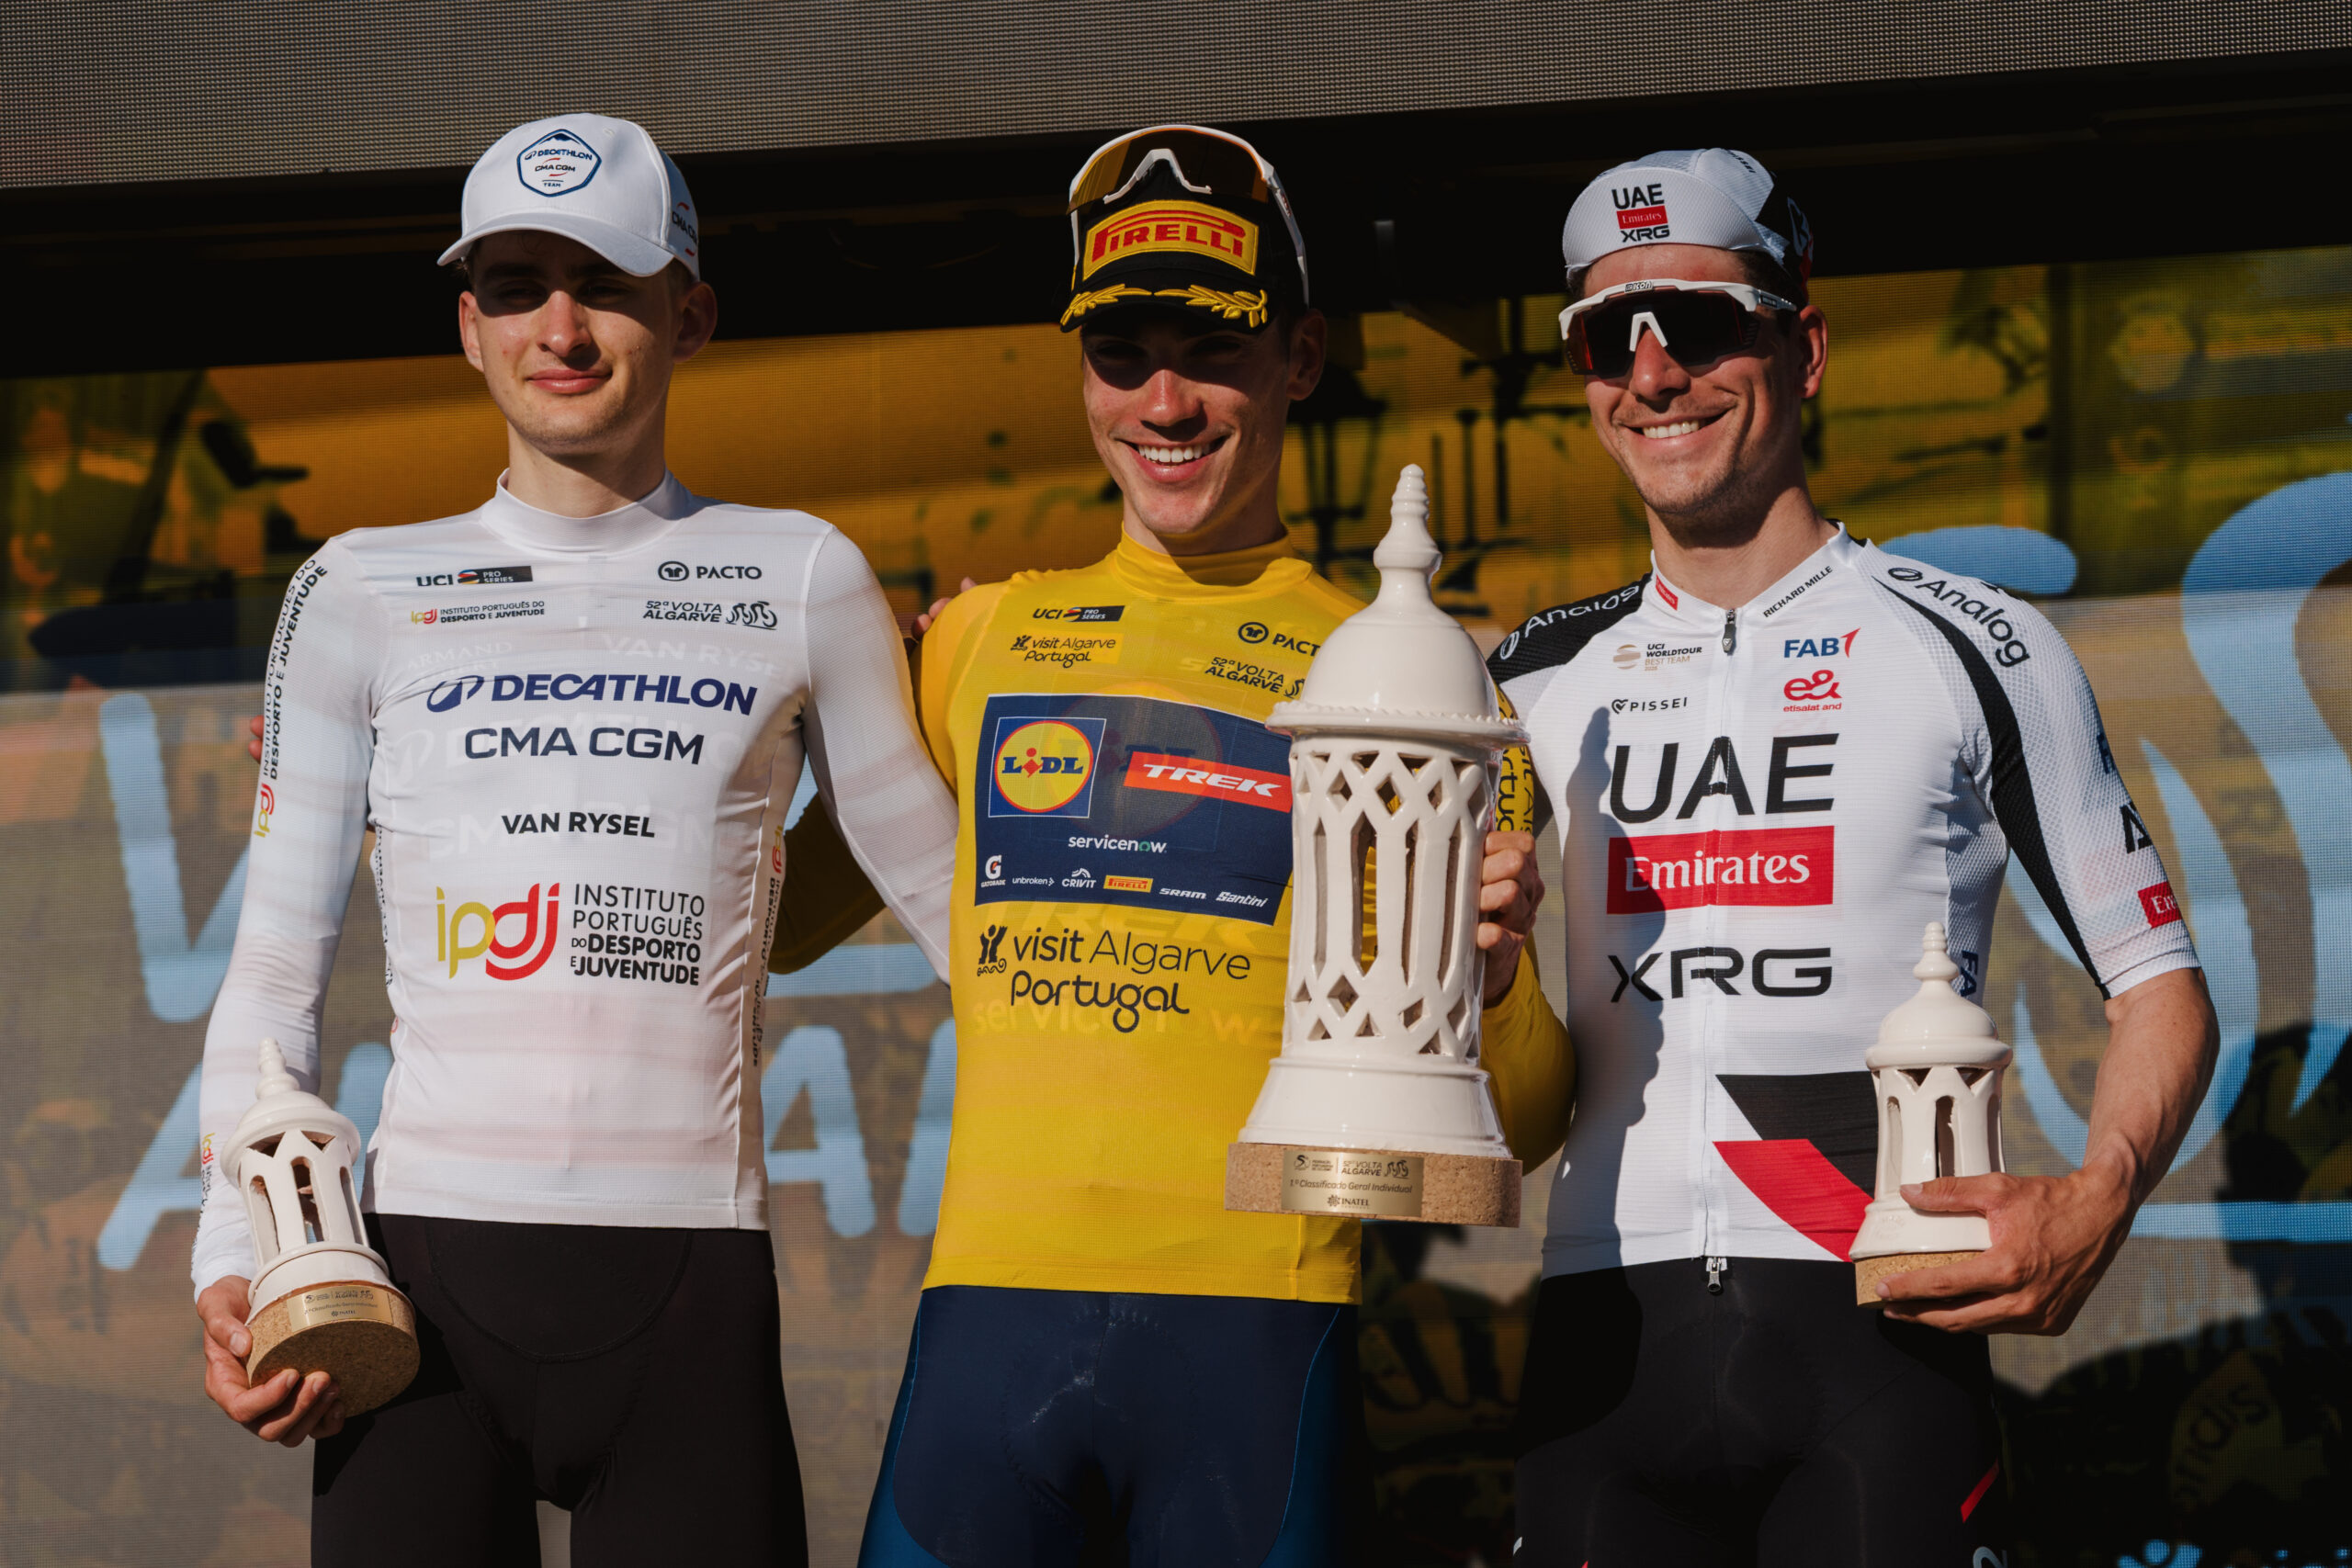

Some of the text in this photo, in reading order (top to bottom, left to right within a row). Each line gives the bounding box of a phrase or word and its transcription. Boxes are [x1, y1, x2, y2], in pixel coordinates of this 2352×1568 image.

[537, 149, 593, 161] DECATHLON
[1611, 183, 1665, 209] UAE
[672, 210, 688, 235] CMA
[1622, 211, 1662, 224] Emirates
[1091, 209, 1246, 262] PIRELLI
[1620, 225, 1670, 243] XRG
[295, 559, 316, 581] DO
[416, 574, 453, 586] UCI
[696, 566, 763, 580] PACTO
[1763, 565, 1833, 618] RICHARD MILLE
[440, 600, 545, 615] INSTITUTO PORTUGUÊS DO
[441, 613, 486, 624] DESPORTO
[495, 608, 545, 619] JUVENTUDE
[643, 610, 722, 623] ALGARVE
[672, 601, 722, 613] VOLTA
[1033, 609, 1063, 620] UCI
[1523, 585, 1640, 638] Analog
[1915, 580, 2031, 669] Analog
[1032, 637, 1116, 651] visit Algarve
[1646, 647, 1702, 657] WORLDTOUR
[1783, 637, 1840, 659] FAB
[1023, 650, 1091, 669] Portugal
[1645, 655, 1690, 666] BEST TEAM
[269, 565, 328, 780] DESPORTO E JUVENTUDE
[1204, 666, 1283, 694] ALGARVE
[1237, 661, 1284, 683] VOLTA
[491, 673, 758, 716] DECATHLON
[1783, 669, 1843, 702] e&
[1630, 697, 1688, 712] PISSEI
[1782, 702, 1842, 713] etisalat and
[464, 727, 705, 765] CMA CGM
[1143, 763, 1282, 797] TREK
[1610, 733, 1839, 824] UAE
[501, 811, 656, 838] VAN RYSEL
[1068, 833, 1167, 853] servicenow
[1012, 876, 1048, 886] unbroken
[1624, 850, 1810, 893] Emirates
[1061, 878, 1097, 888] CRIVIT
[1108, 877, 1148, 890] PIRELLI
[1159, 887, 1207, 899] SRAM
[573, 883, 706, 918] INSTITUTO
[1216, 891, 1269, 908] Santini
[572, 908, 704, 941] PORTUGUÊS
[571, 933, 701, 964] DO DESPORTO
[1013, 927, 1251, 980] visit Algarve
[571, 955, 699, 986] E JUVENTUDE
[1608, 947, 1832, 1003] XRG
[1960, 950, 1979, 997] FA
[1011, 970, 1190, 1033] Portugal
[1341, 1168, 1383, 1177] ALGARVE
[1356, 1161, 1383, 1169] VOLTA
[1299, 1179, 1347, 1190] Classificado
[1348, 1181, 1370, 1190] Geral
[1372, 1183, 1412, 1193] Individual
[1341, 1198, 1370, 1206] INATEL
